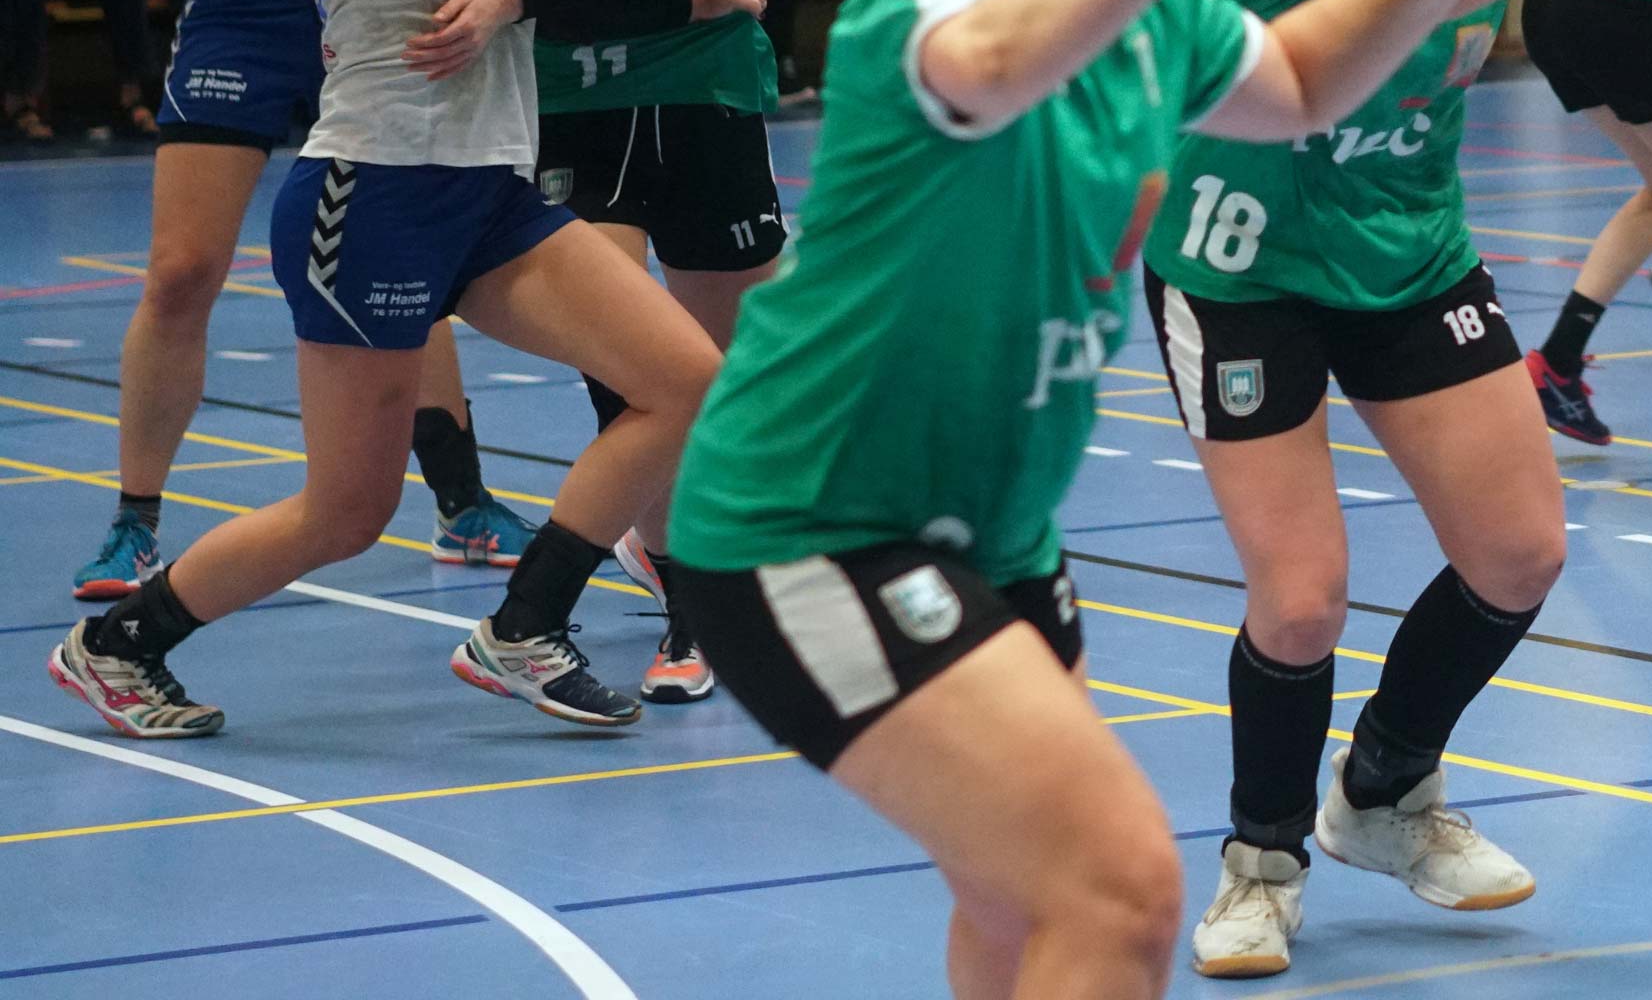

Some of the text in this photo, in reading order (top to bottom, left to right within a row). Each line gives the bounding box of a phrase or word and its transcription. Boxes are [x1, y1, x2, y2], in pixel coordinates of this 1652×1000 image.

[572, 44, 628, 89] 11
[185, 77, 203, 89] JM
[730, 219, 756, 250] 11
[1181, 174, 1268, 273] 18
[365, 290, 431, 305] JM Handel
[372, 308, 386, 316] 76
[388, 308, 401, 316] 77
[403, 308, 415, 317] 57
[1442, 304, 1485, 346] 18
